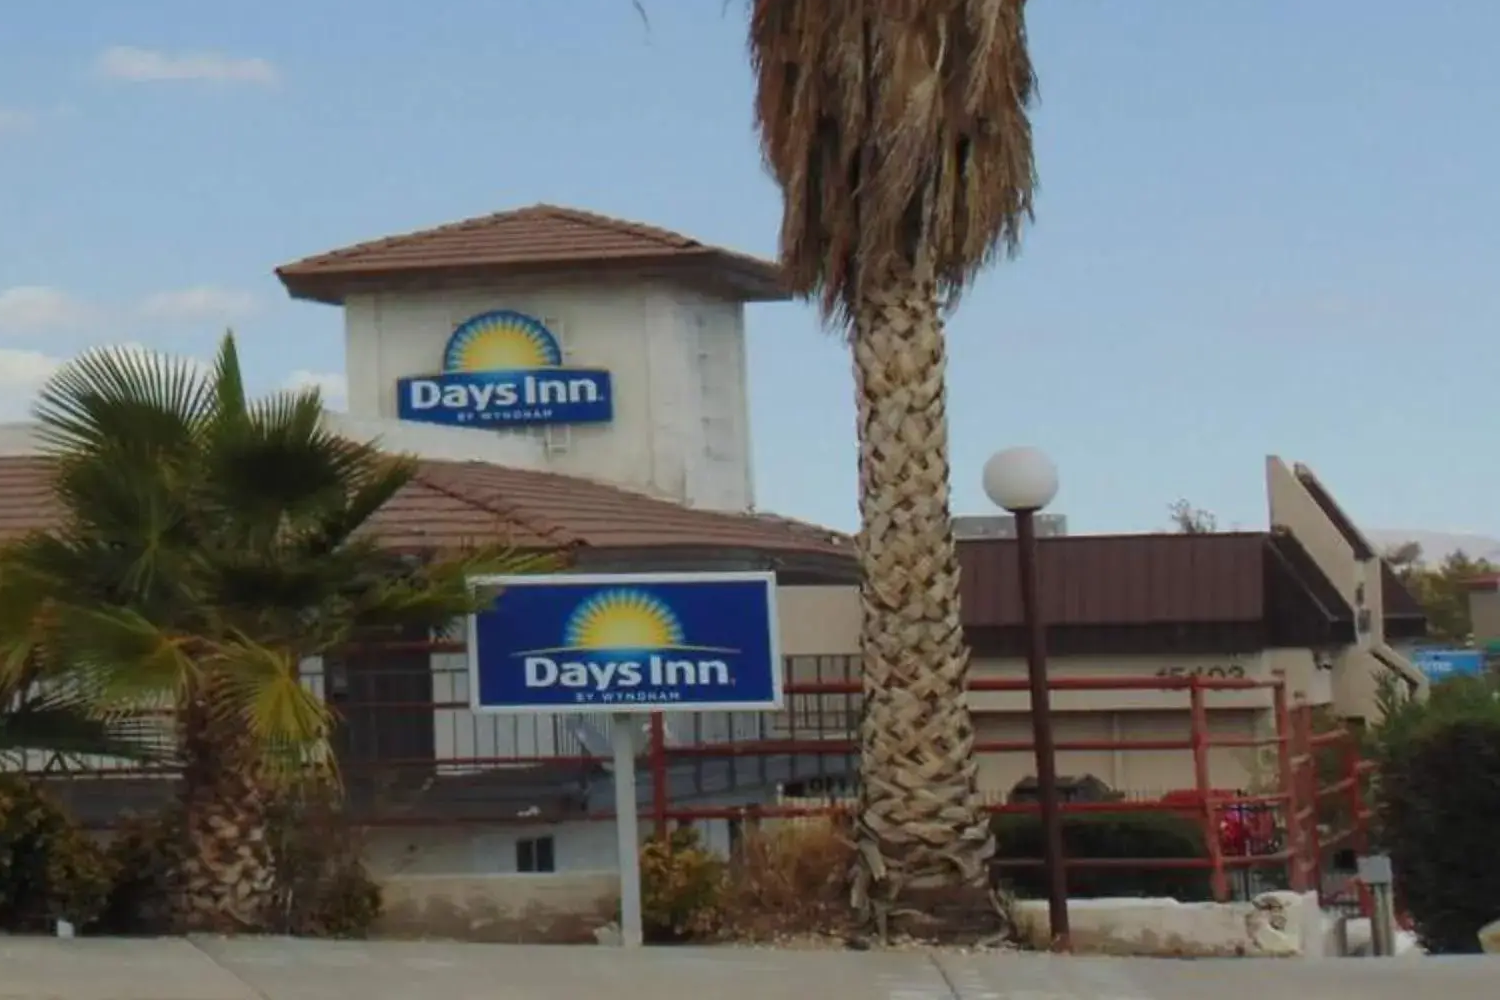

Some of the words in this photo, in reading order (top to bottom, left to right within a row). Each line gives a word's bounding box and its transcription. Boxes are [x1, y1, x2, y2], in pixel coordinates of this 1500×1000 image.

[410, 379, 517, 411] Days
[524, 375, 597, 404] Inn
[457, 411, 475, 422] BY
[481, 409, 553, 421] WYNDHAM
[525, 656, 643, 690] Days
[651, 655, 729, 685] Inn
[576, 692, 596, 701] BY
[602, 691, 681, 702] WYNDHAM
